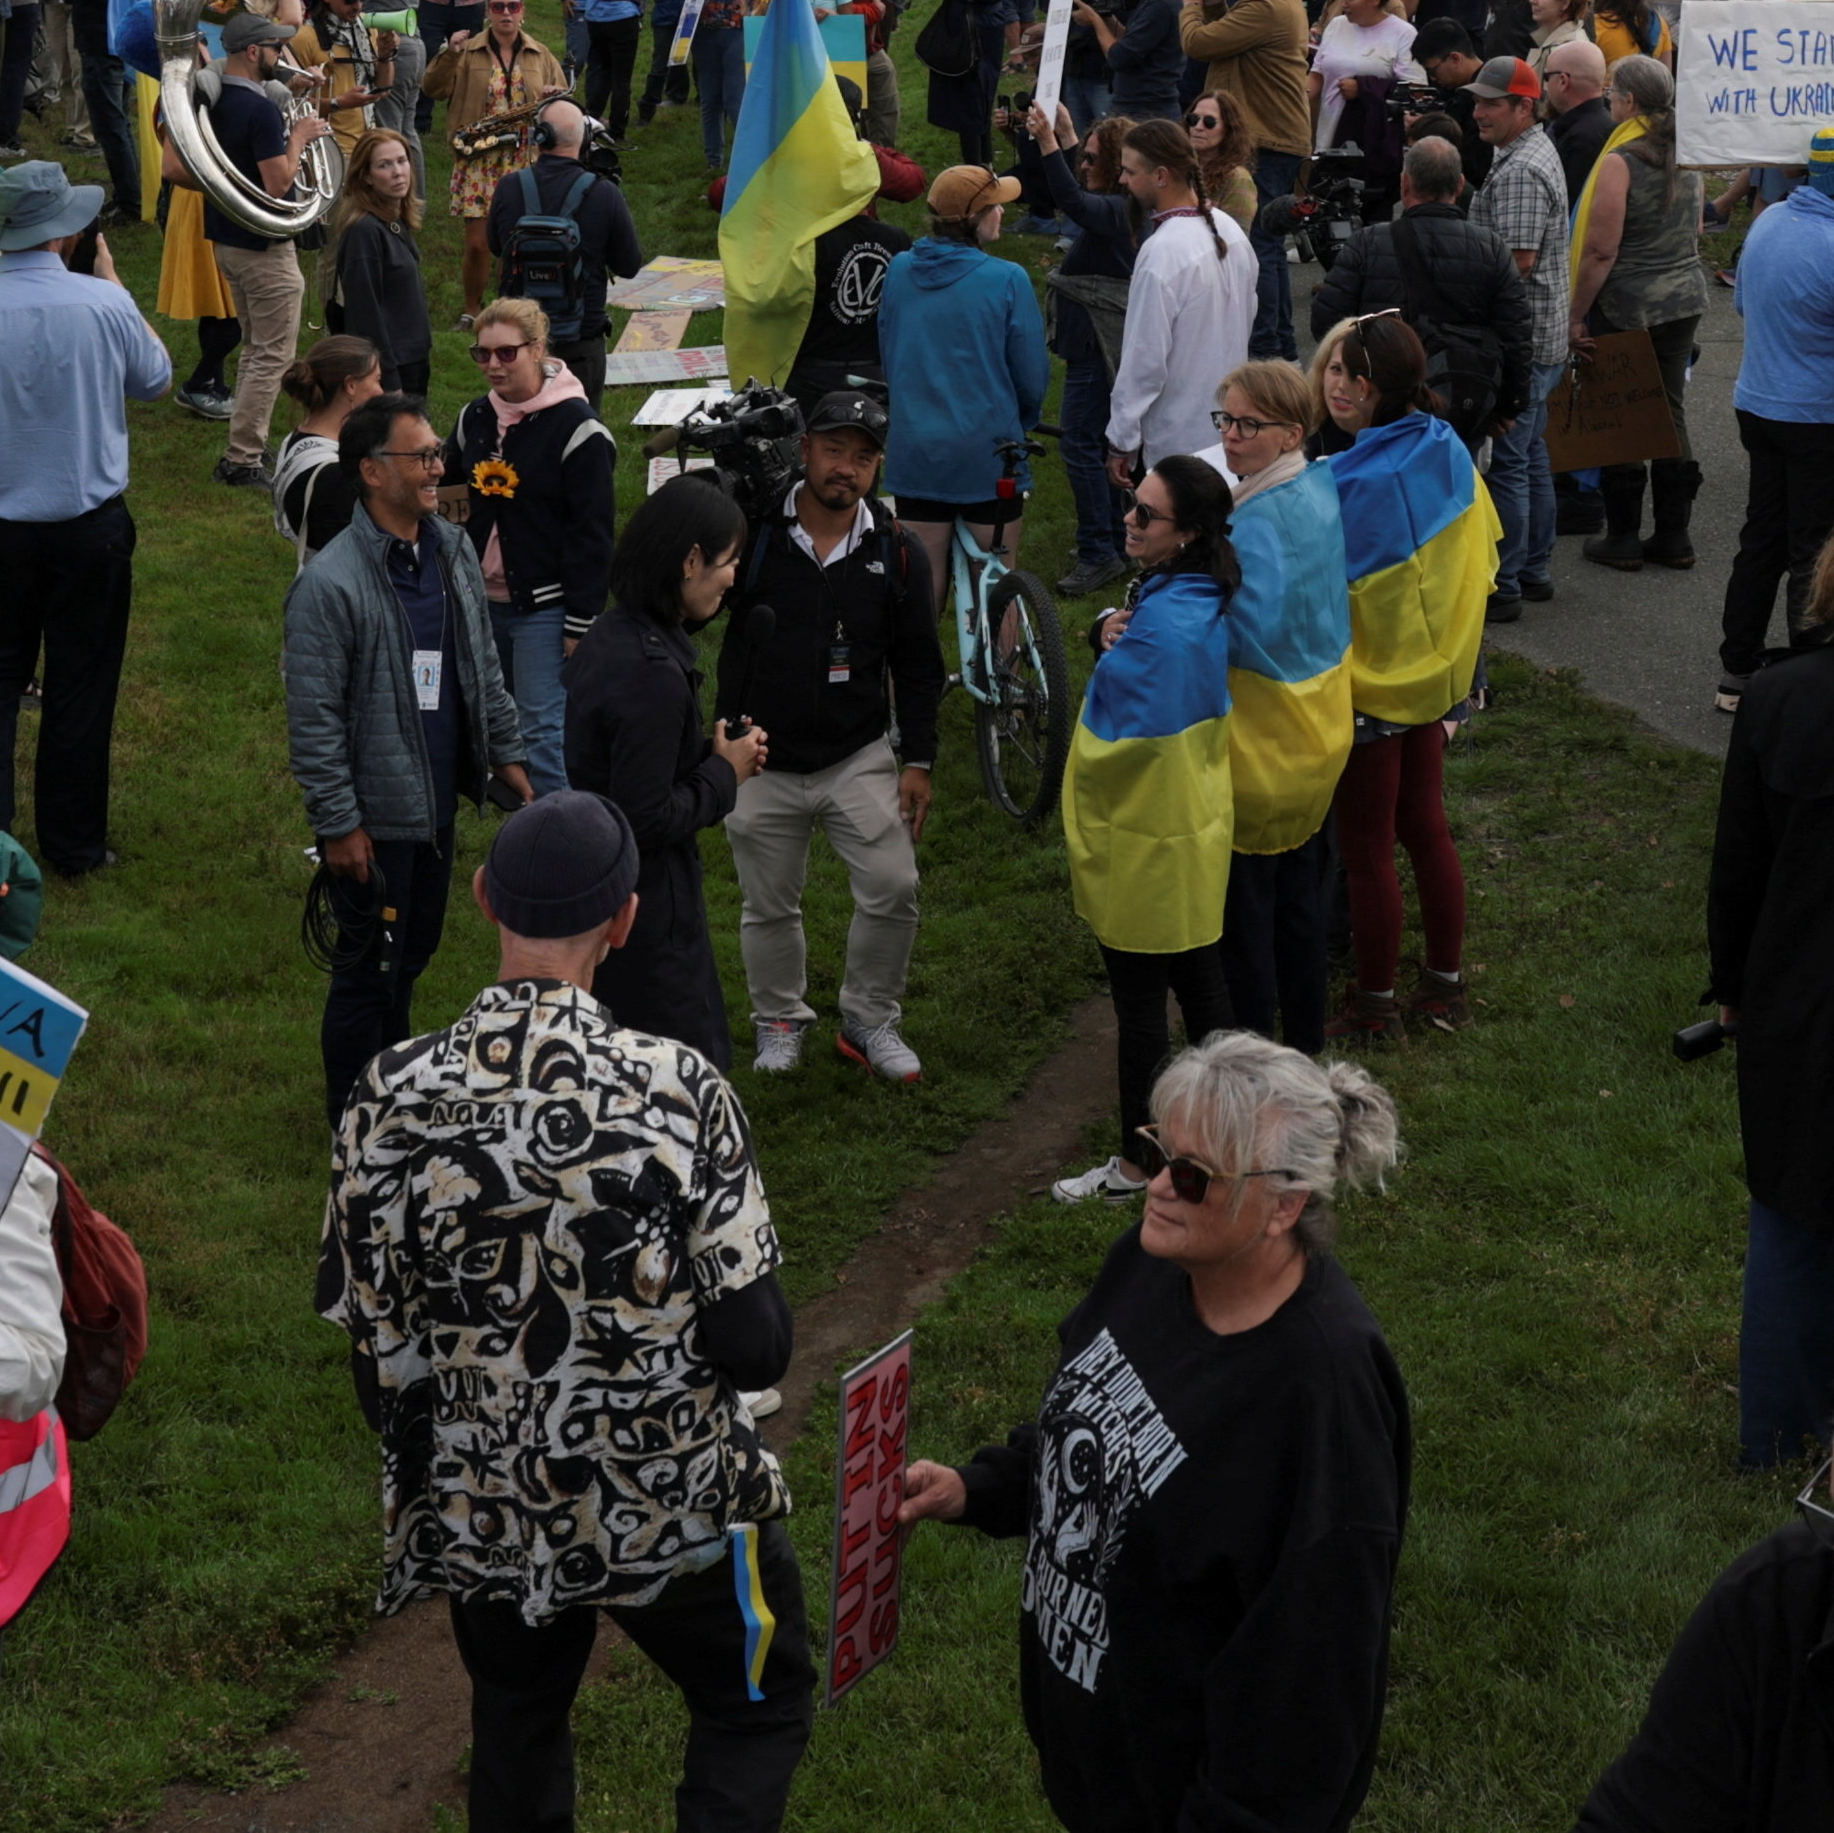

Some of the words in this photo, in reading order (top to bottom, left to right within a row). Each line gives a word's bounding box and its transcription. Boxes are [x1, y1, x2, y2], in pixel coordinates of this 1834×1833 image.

[1705, 87, 1758, 115] WITH
[1707, 28, 1758, 71] WE
[529, 270, 557, 281] LiveU
[1063, 1326, 1126, 1383] THEY
[1102, 1362, 1157, 1430] DIDN'T
[1132, 1412, 1189, 1500] BURN
[1066, 1382, 1132, 1485] WITCHES
[869, 1360, 909, 1658] SUCKS
[1021, 1563, 1110, 1695] OMEN
